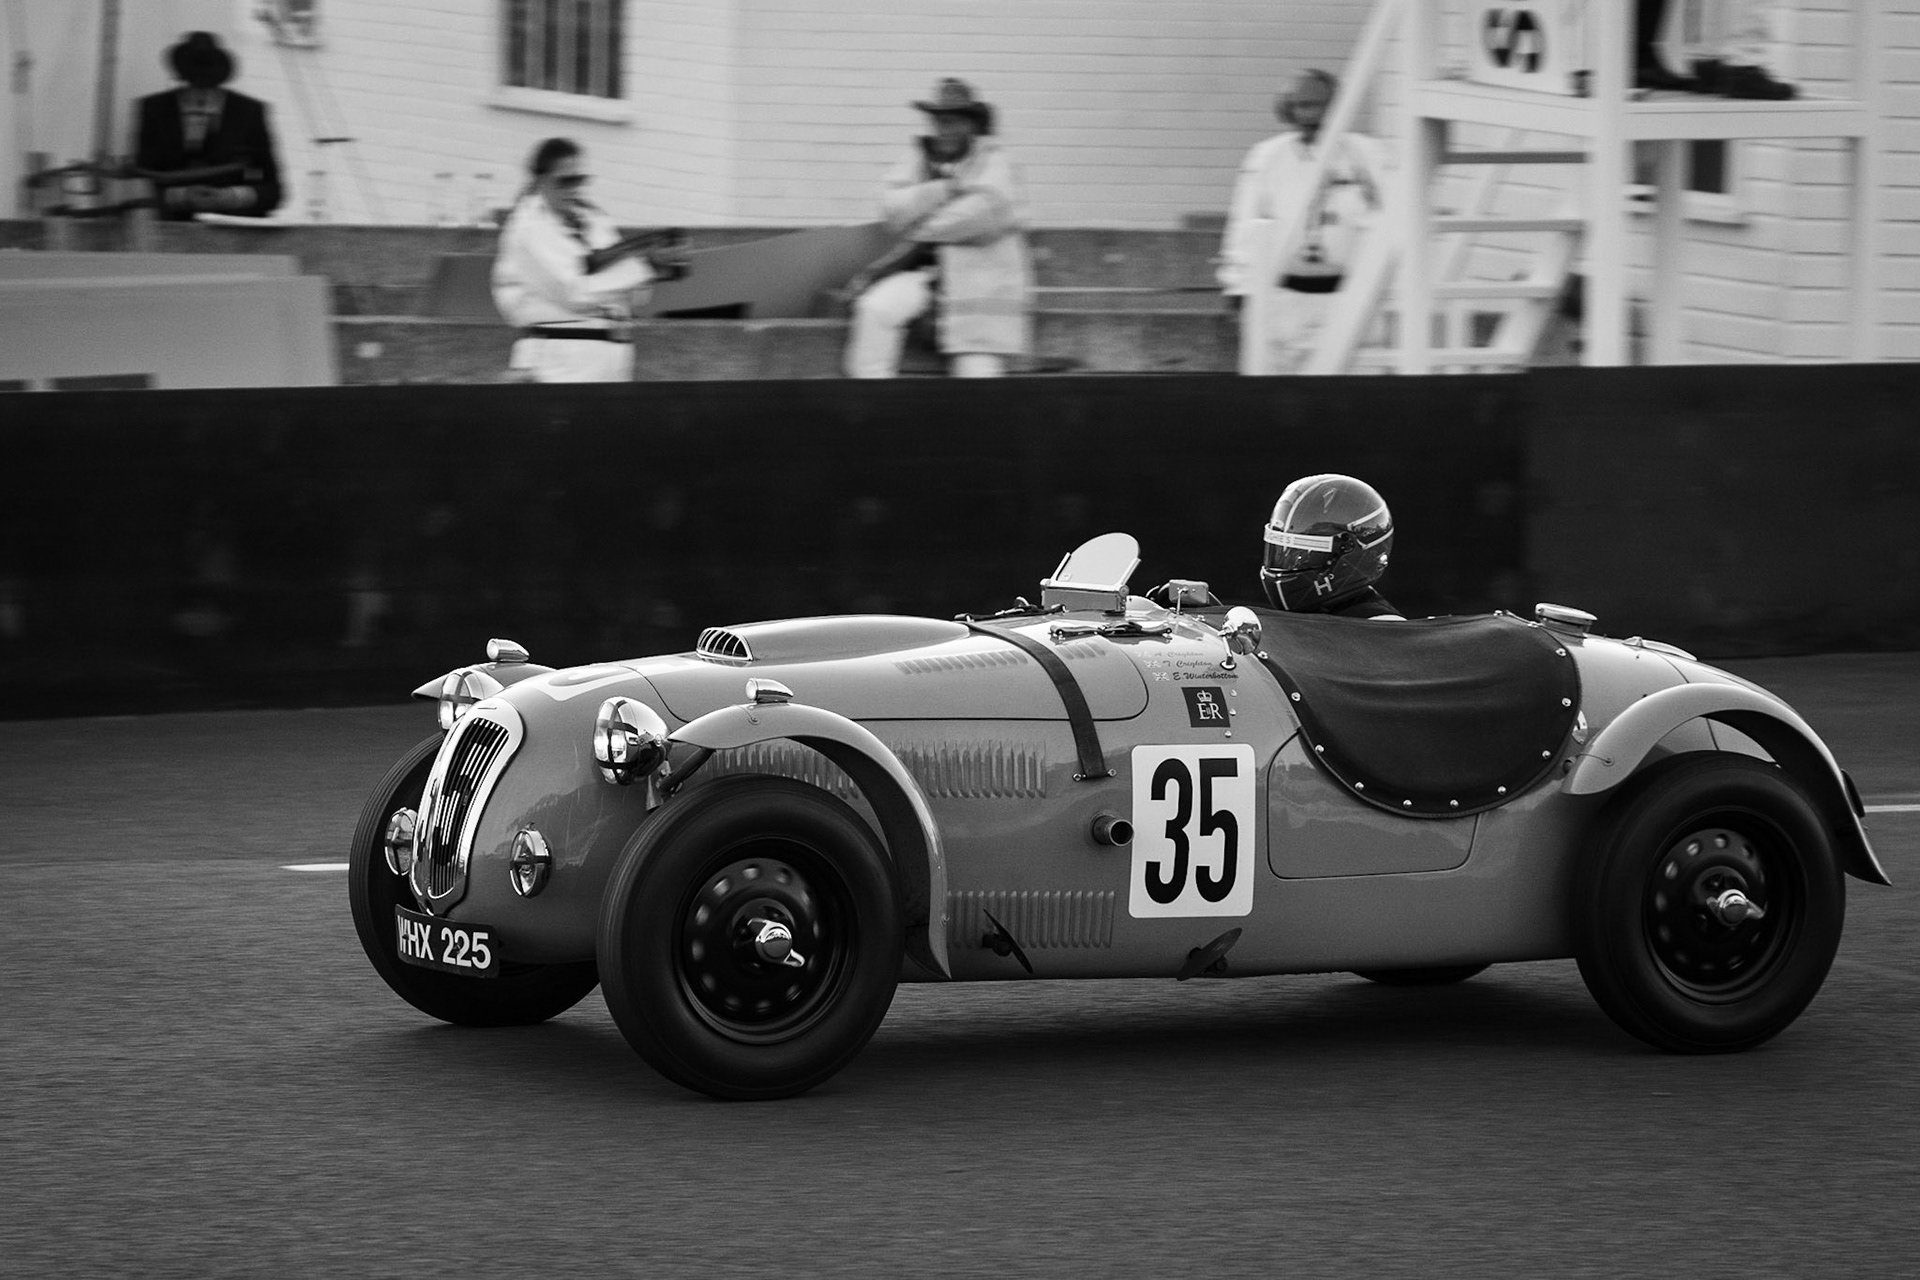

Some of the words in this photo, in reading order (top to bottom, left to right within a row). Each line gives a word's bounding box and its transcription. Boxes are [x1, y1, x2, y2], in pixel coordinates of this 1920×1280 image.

[1145, 758, 1238, 904] 35
[397, 915, 434, 960] WHX
[441, 927, 492, 969] 225
